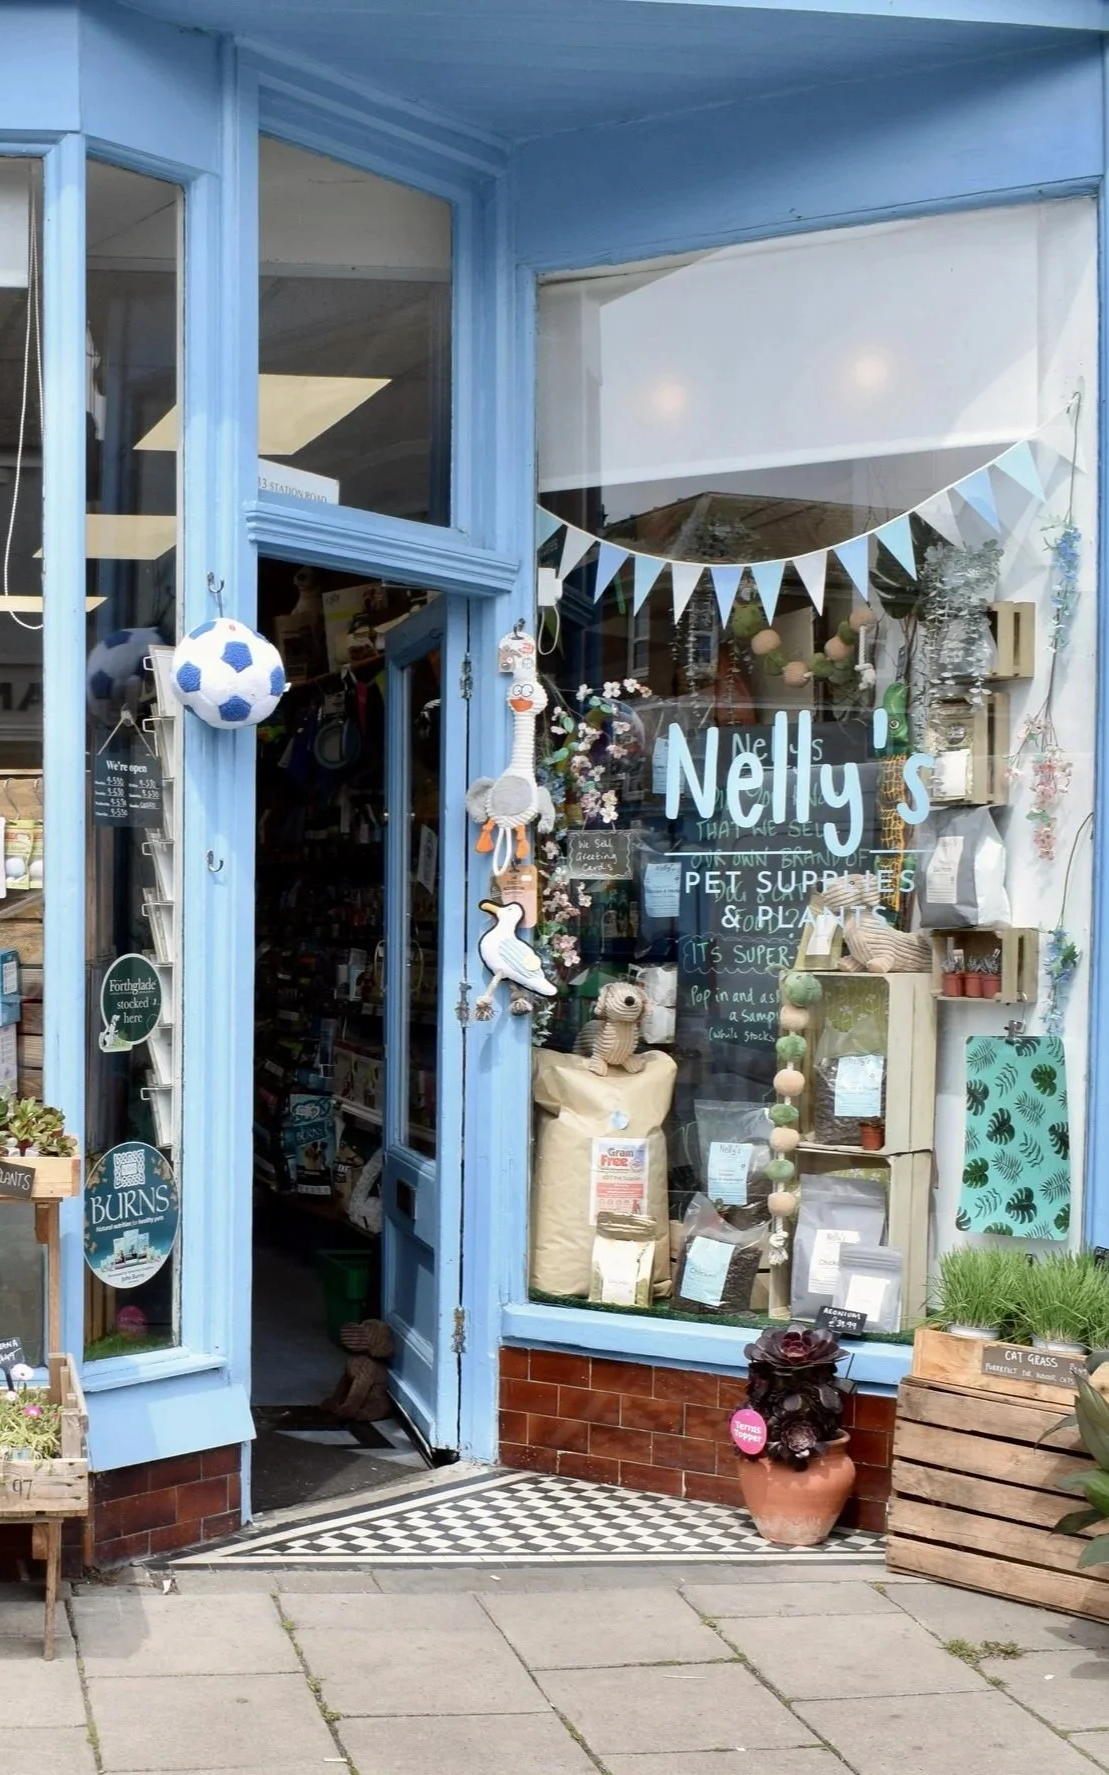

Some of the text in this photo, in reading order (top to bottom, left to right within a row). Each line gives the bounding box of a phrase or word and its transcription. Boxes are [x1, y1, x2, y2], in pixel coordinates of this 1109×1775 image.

[270, 482, 304, 499] STATION
[106, 760, 148, 775] We're open
[664, 708, 935, 857] Nelly's
[753, 821, 778, 837] WE
[578, 838, 613, 849] We Sell
[575, 852, 618, 864] Greeting
[690, 847, 870, 870] OUR OWN BRAND OF
[581, 864, 614, 872] Cards
[685, 869, 915, 895] PET SUPPLIES
[721, 904, 890, 929] & PLANTS
[109, 978, 156, 995] Forthglade
[117, 996, 149, 1010] stocked
[691, 984, 710, 1010] Pop
[716, 986, 729, 1005] in
[732, 988, 756, 1006] and
[123, 1011, 143, 1024] here
[728, 1011, 738, 1021] a
[600, 1155, 624, 1167] Free
[89, 1184, 170, 1225] BURNS
[823, 1307, 861, 1320] AEONIUM
[1004, 1350, 1059, 1369] CAT GRASS
[733, 1428, 763, 1443] Topper
[12, 1478, 33, 1500] 97
